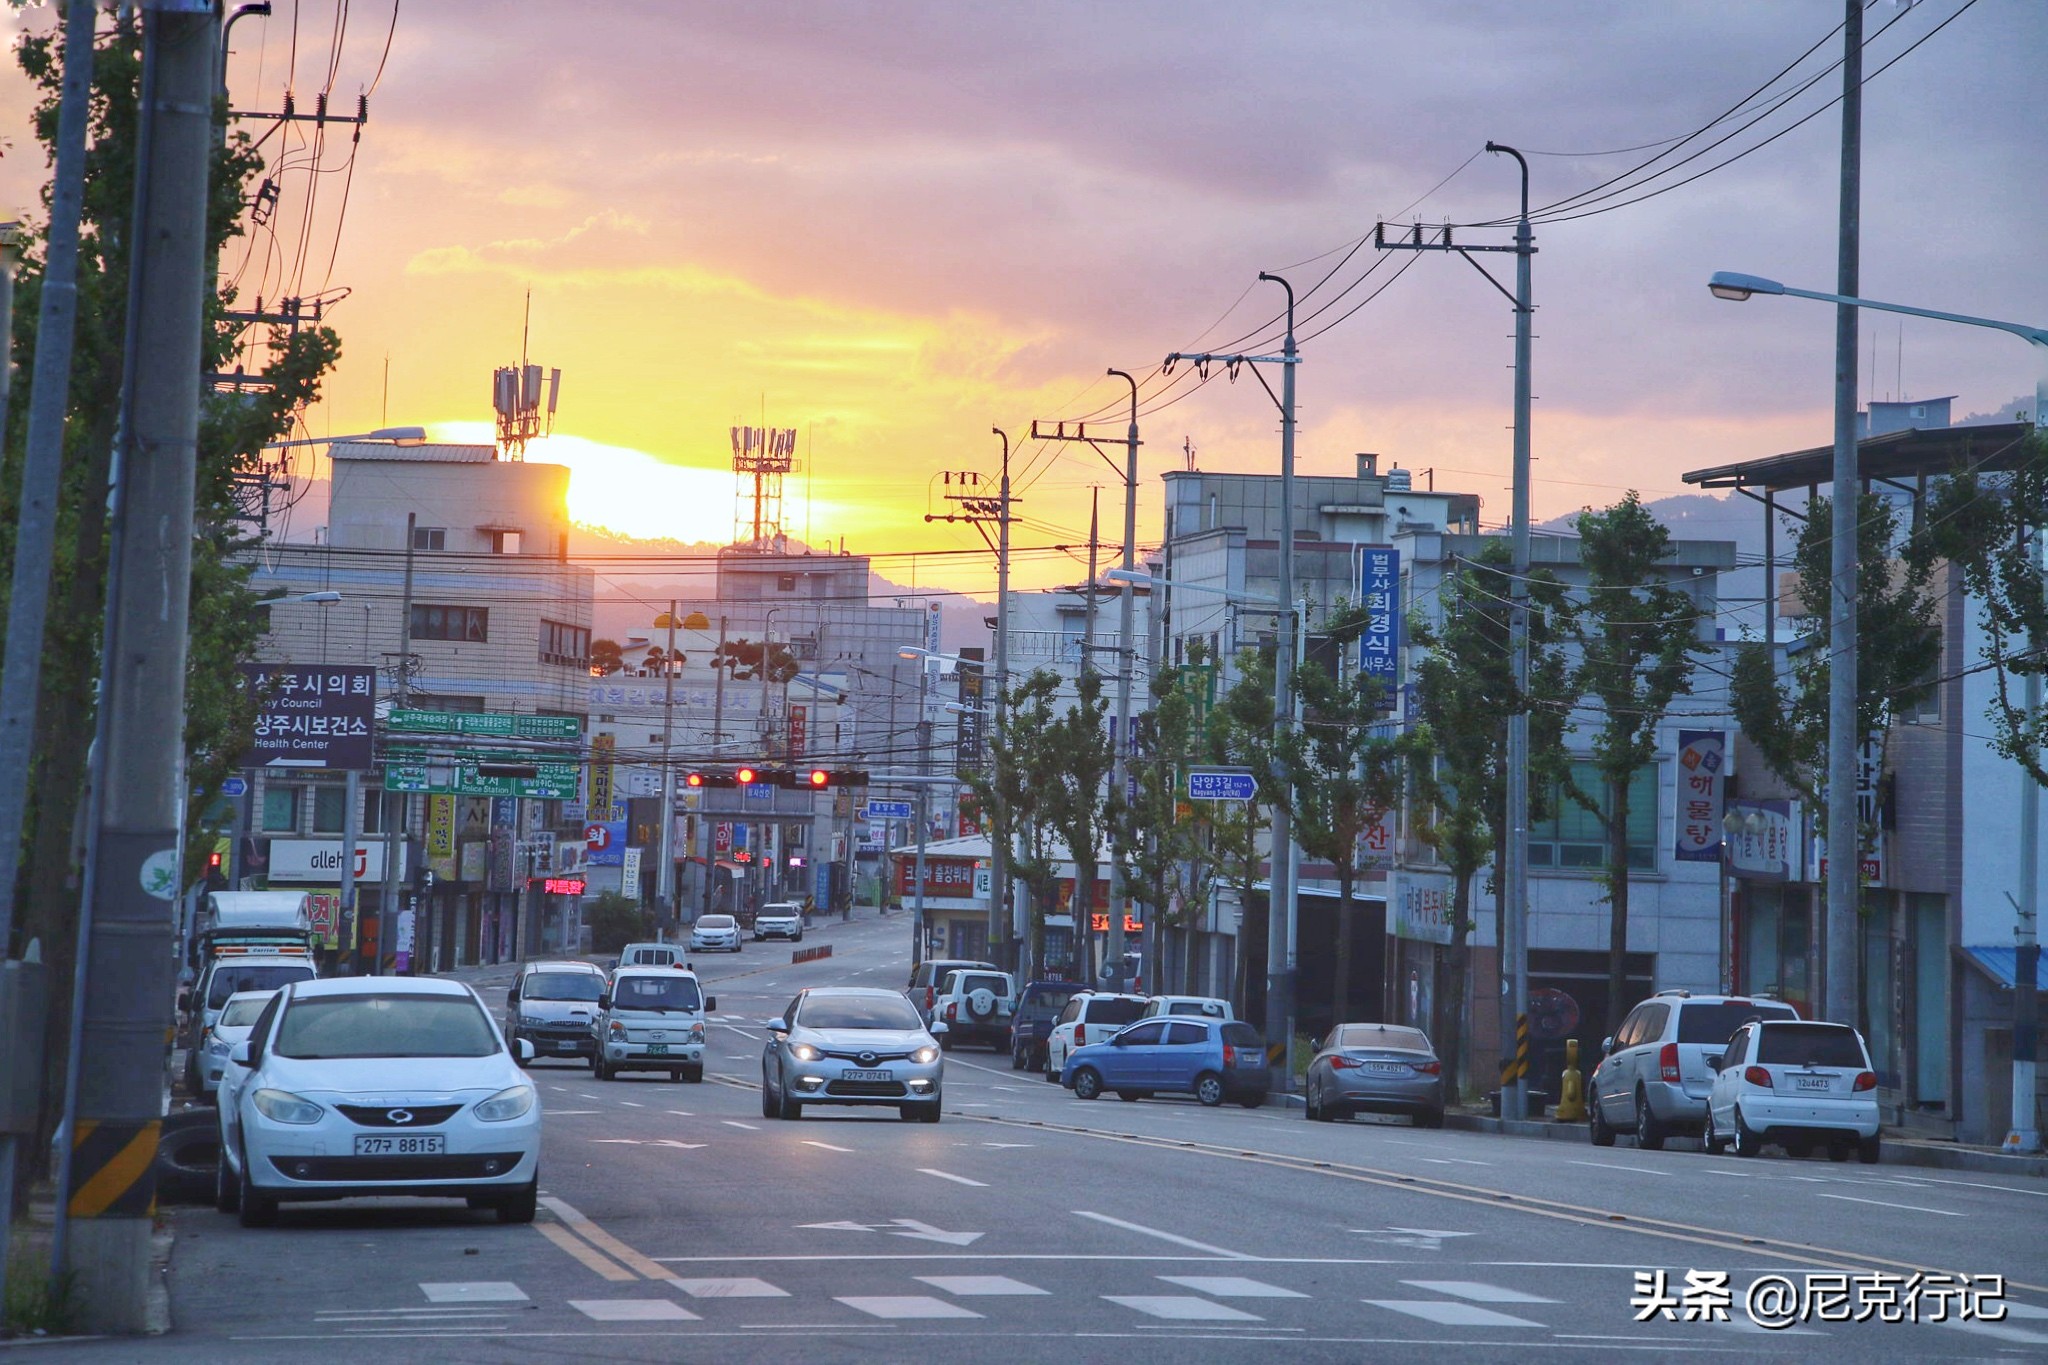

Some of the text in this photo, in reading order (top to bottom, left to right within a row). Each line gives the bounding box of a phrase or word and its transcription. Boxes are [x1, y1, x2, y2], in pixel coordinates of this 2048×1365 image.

[1371, 554, 1390, 589] 법무사
[1366, 592, 1390, 655] 최경식
[1363, 657, 1395, 671] 사무소
[281, 698, 322, 708] Council
[253, 714, 368, 736] 상주시보건소
[254, 739, 330, 749] Health Center
[461, 784, 509, 795] Police Station
[1193, 777, 1232, 789] 낙양3길
[1686, 775, 1713, 846] 해물탕
[364, 1138, 436, 1153] 27구 8815
